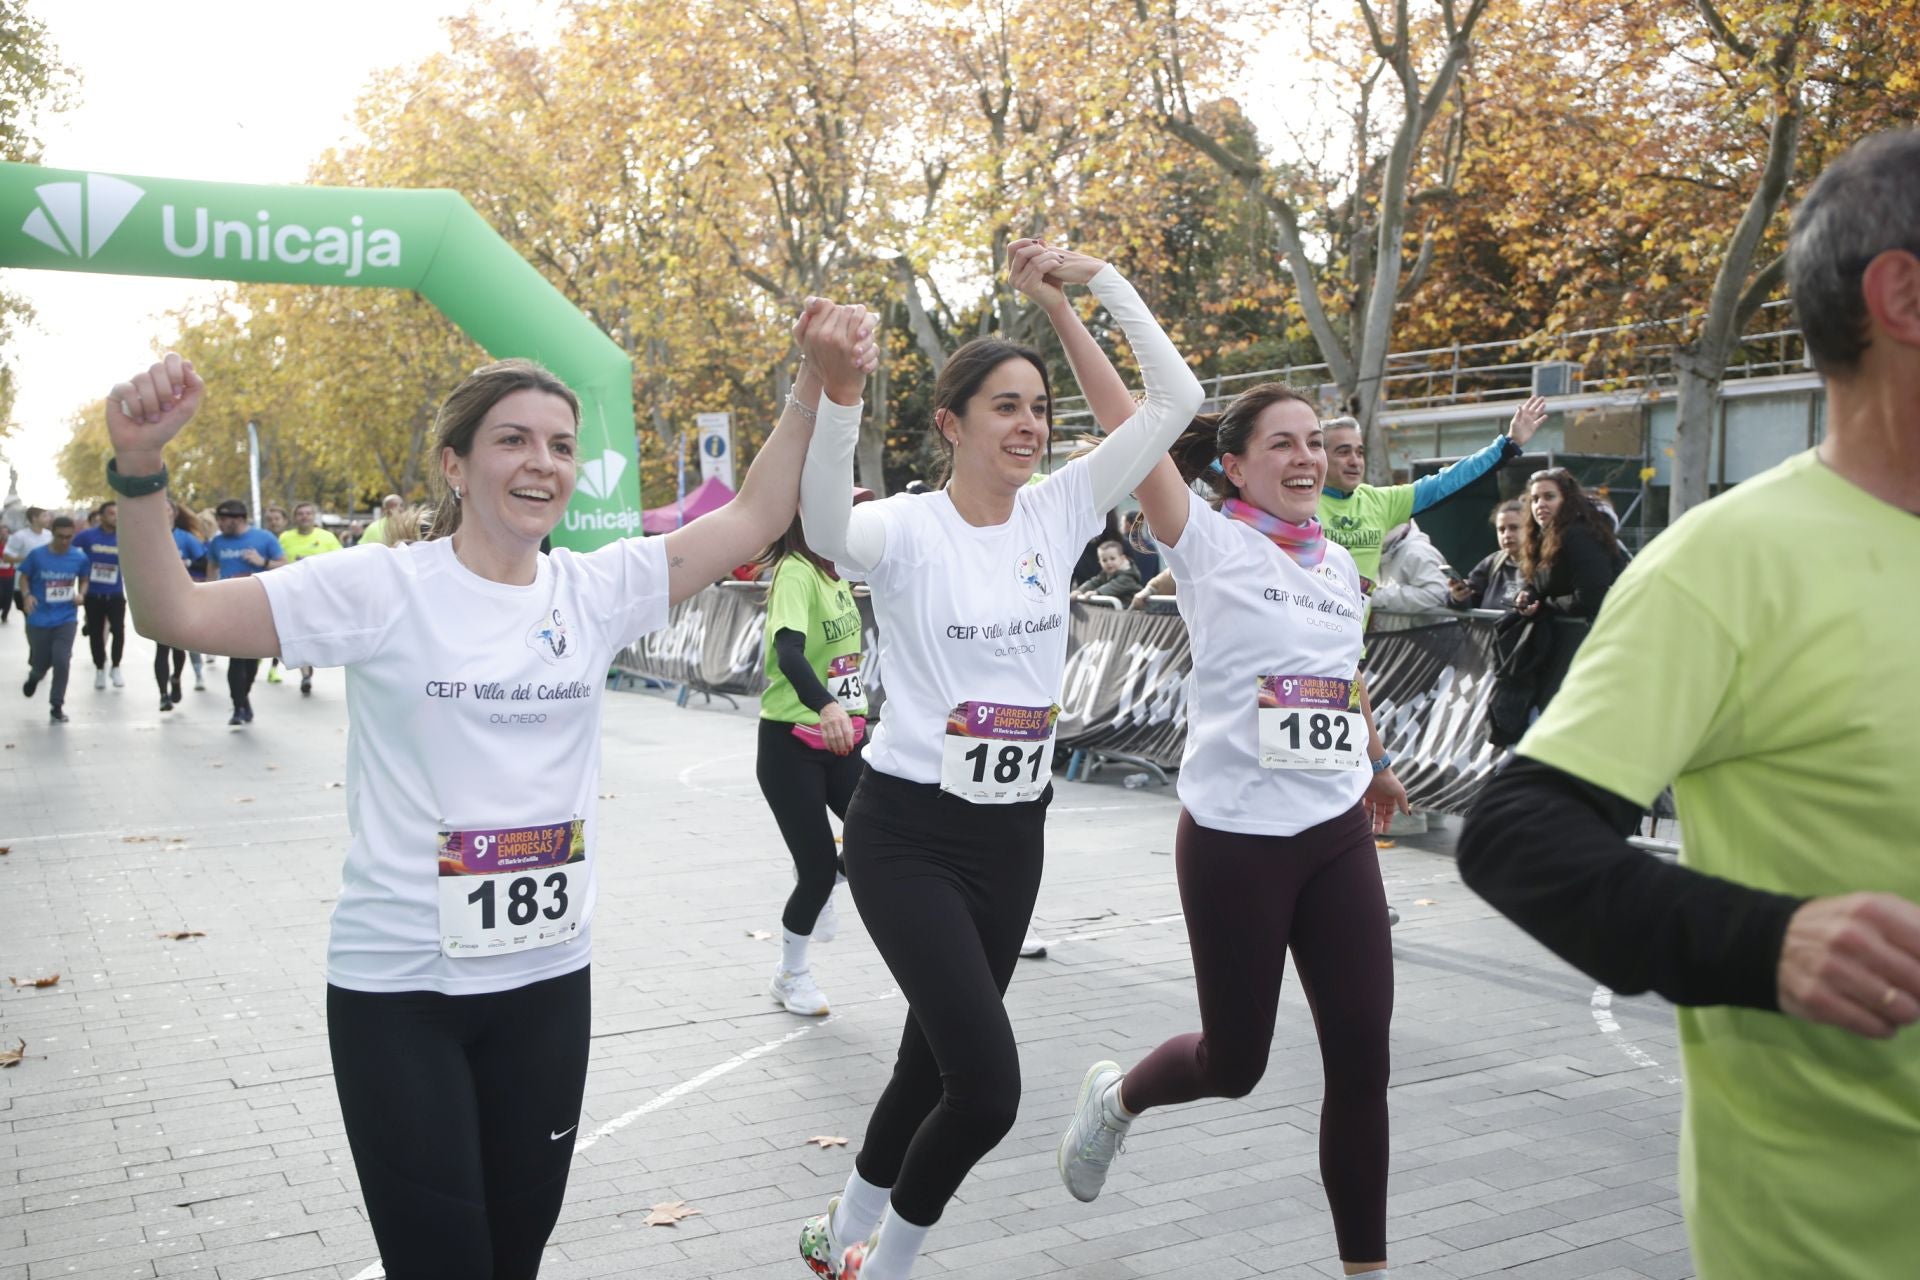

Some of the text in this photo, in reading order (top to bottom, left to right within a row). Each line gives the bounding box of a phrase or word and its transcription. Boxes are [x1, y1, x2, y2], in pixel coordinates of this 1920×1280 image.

[162, 204, 401, 277] Unicaja
[564, 506, 641, 537] Unicaja
[50, 587, 70, 597] 497
[1264, 588, 1289, 602] CEIP
[1292, 594, 1314, 610] Villa
[1317, 599, 1333, 614] del
[946, 614, 1062, 640] CEIP Villa del Caballer
[1306, 617, 1343, 633] OLMEDO
[994, 644, 1036, 657] OLMEDO
[426, 680, 466, 699] CEIP
[474, 682, 504, 700] Villa
[511, 683, 532, 700] del
[837, 675, 864, 699] 43
[1282, 679, 1337, 696] 9ª CARRERA DE
[1299, 687, 1338, 699] EMPRESAS
[489, 713, 548, 724] OLMEDO
[977, 705, 1043, 724] 9ª CARRERA DE
[994, 717, 1040, 729] EMPRESAS
[1279, 712, 1352, 752] 182
[965, 742, 1045, 784] 181
[474, 829, 553, 858] 9ª CARRERA DE
[497, 839, 553, 858] EMPRESAS
[467, 871, 569, 930] 183
